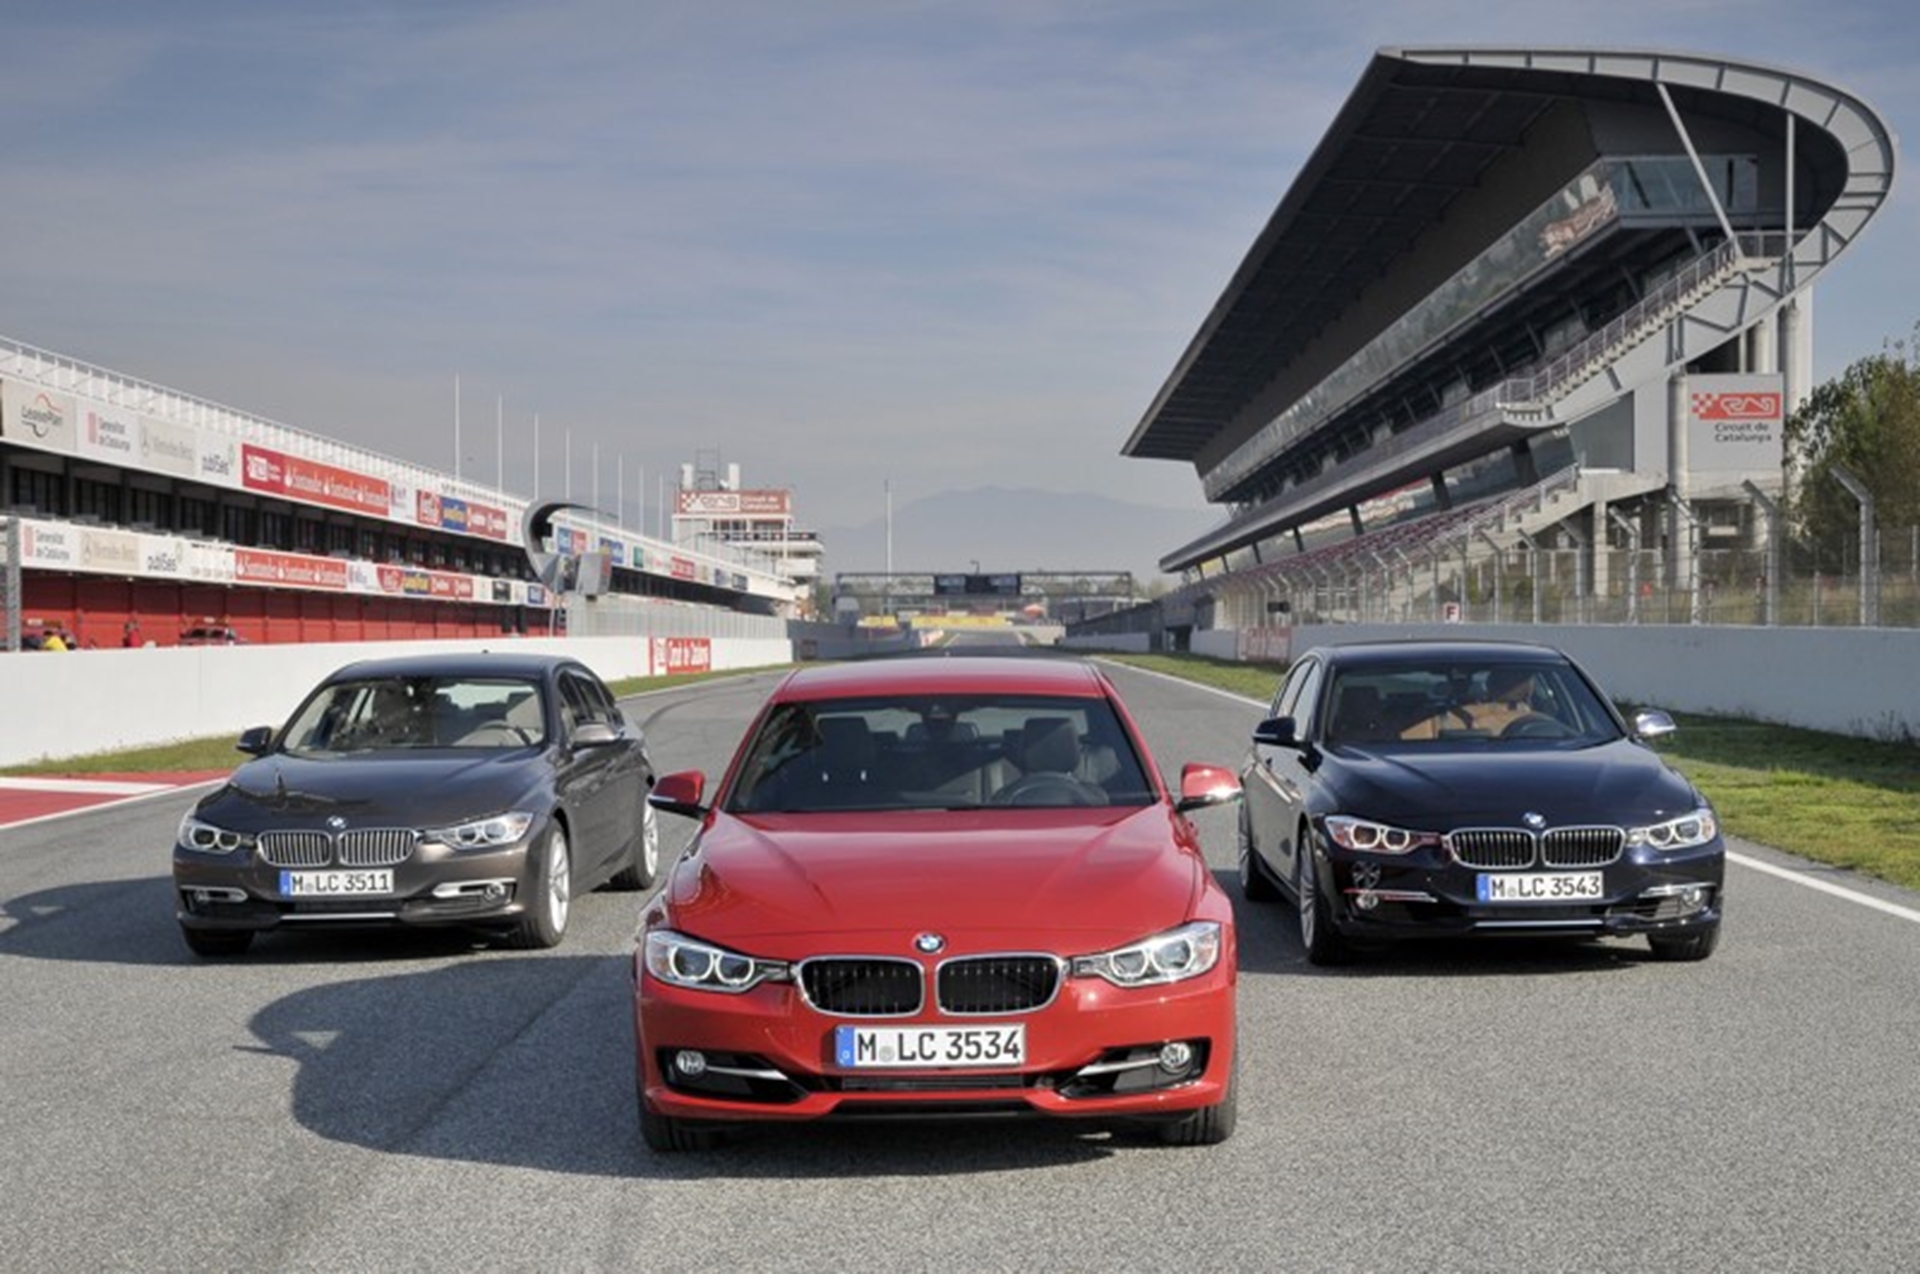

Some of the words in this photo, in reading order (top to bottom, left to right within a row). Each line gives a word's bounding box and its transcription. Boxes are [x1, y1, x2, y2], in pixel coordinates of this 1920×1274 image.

[1715, 422, 1751, 433] Circuit
[1754, 422, 1769, 433] de
[1714, 433, 1772, 445] Catalunya
[1446, 605, 1457, 620] F
[315, 873, 340, 892] LC
[344, 873, 390, 892] 3511
[1518, 877, 1545, 898] LC
[1550, 875, 1600, 897] 3543
[857, 1032, 877, 1061] M
[898, 1031, 937, 1061] LC
[945, 1029, 1020, 1060] 3534
